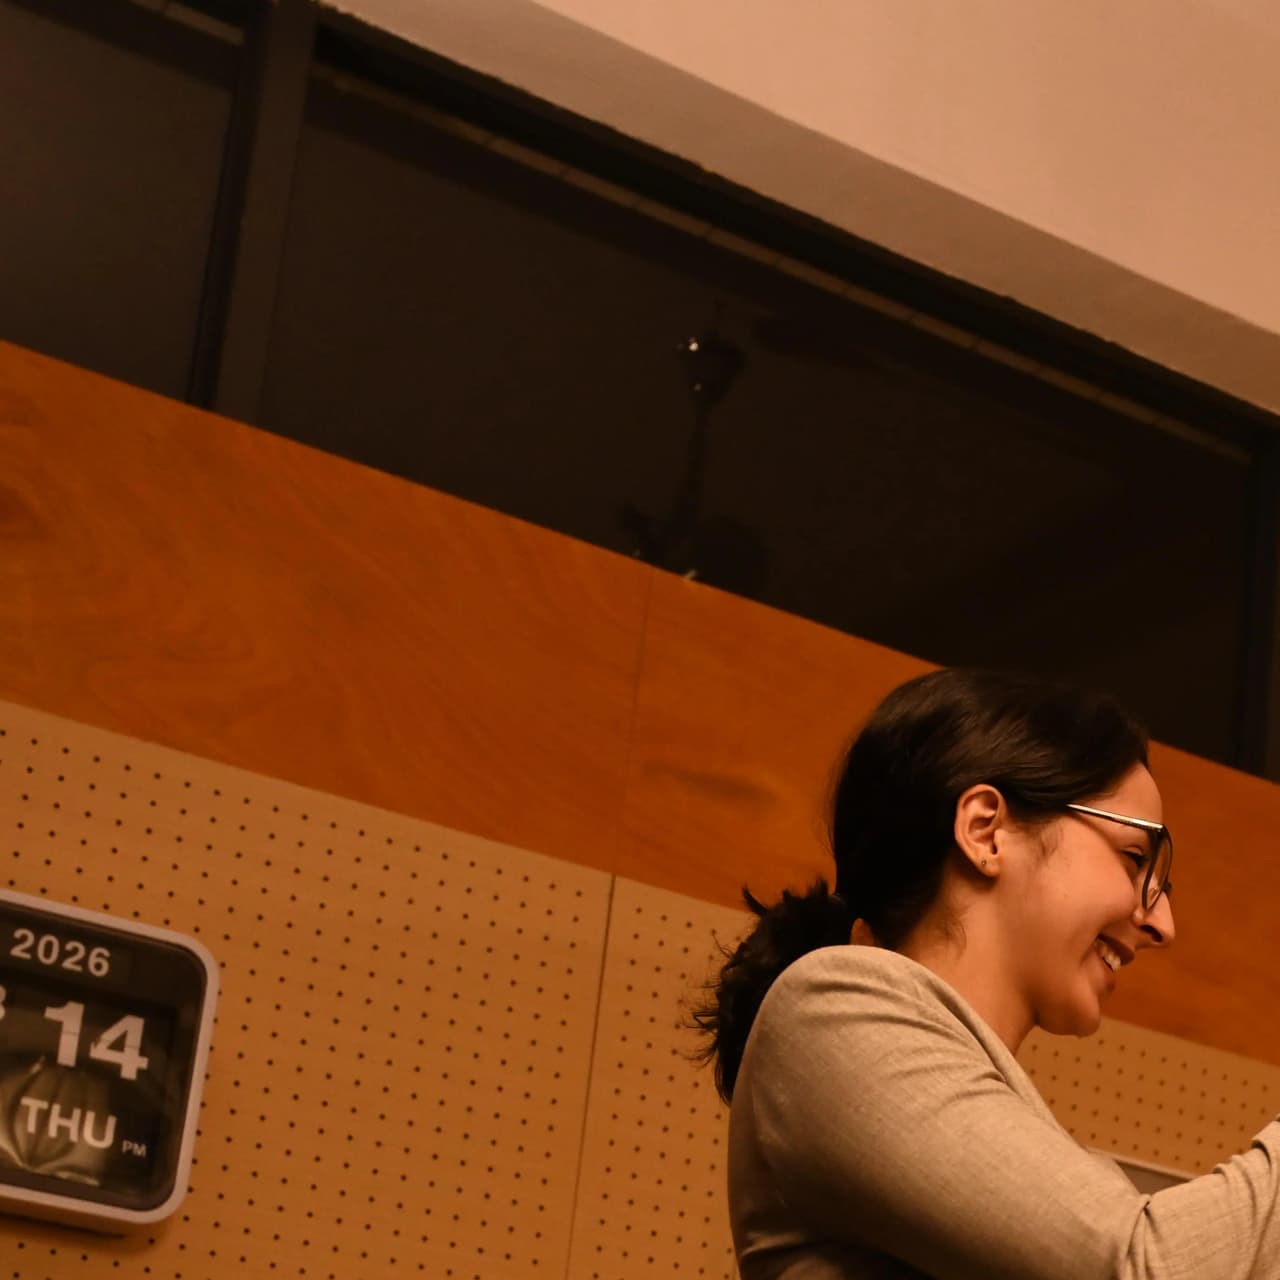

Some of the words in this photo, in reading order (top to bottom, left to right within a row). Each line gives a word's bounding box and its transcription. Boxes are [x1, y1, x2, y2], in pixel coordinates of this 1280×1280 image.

[11, 929, 110, 977] 2026
[45, 1002, 148, 1080] 14
[21, 1097, 117, 1149] THU
[122, 1140, 147, 1157] PM
